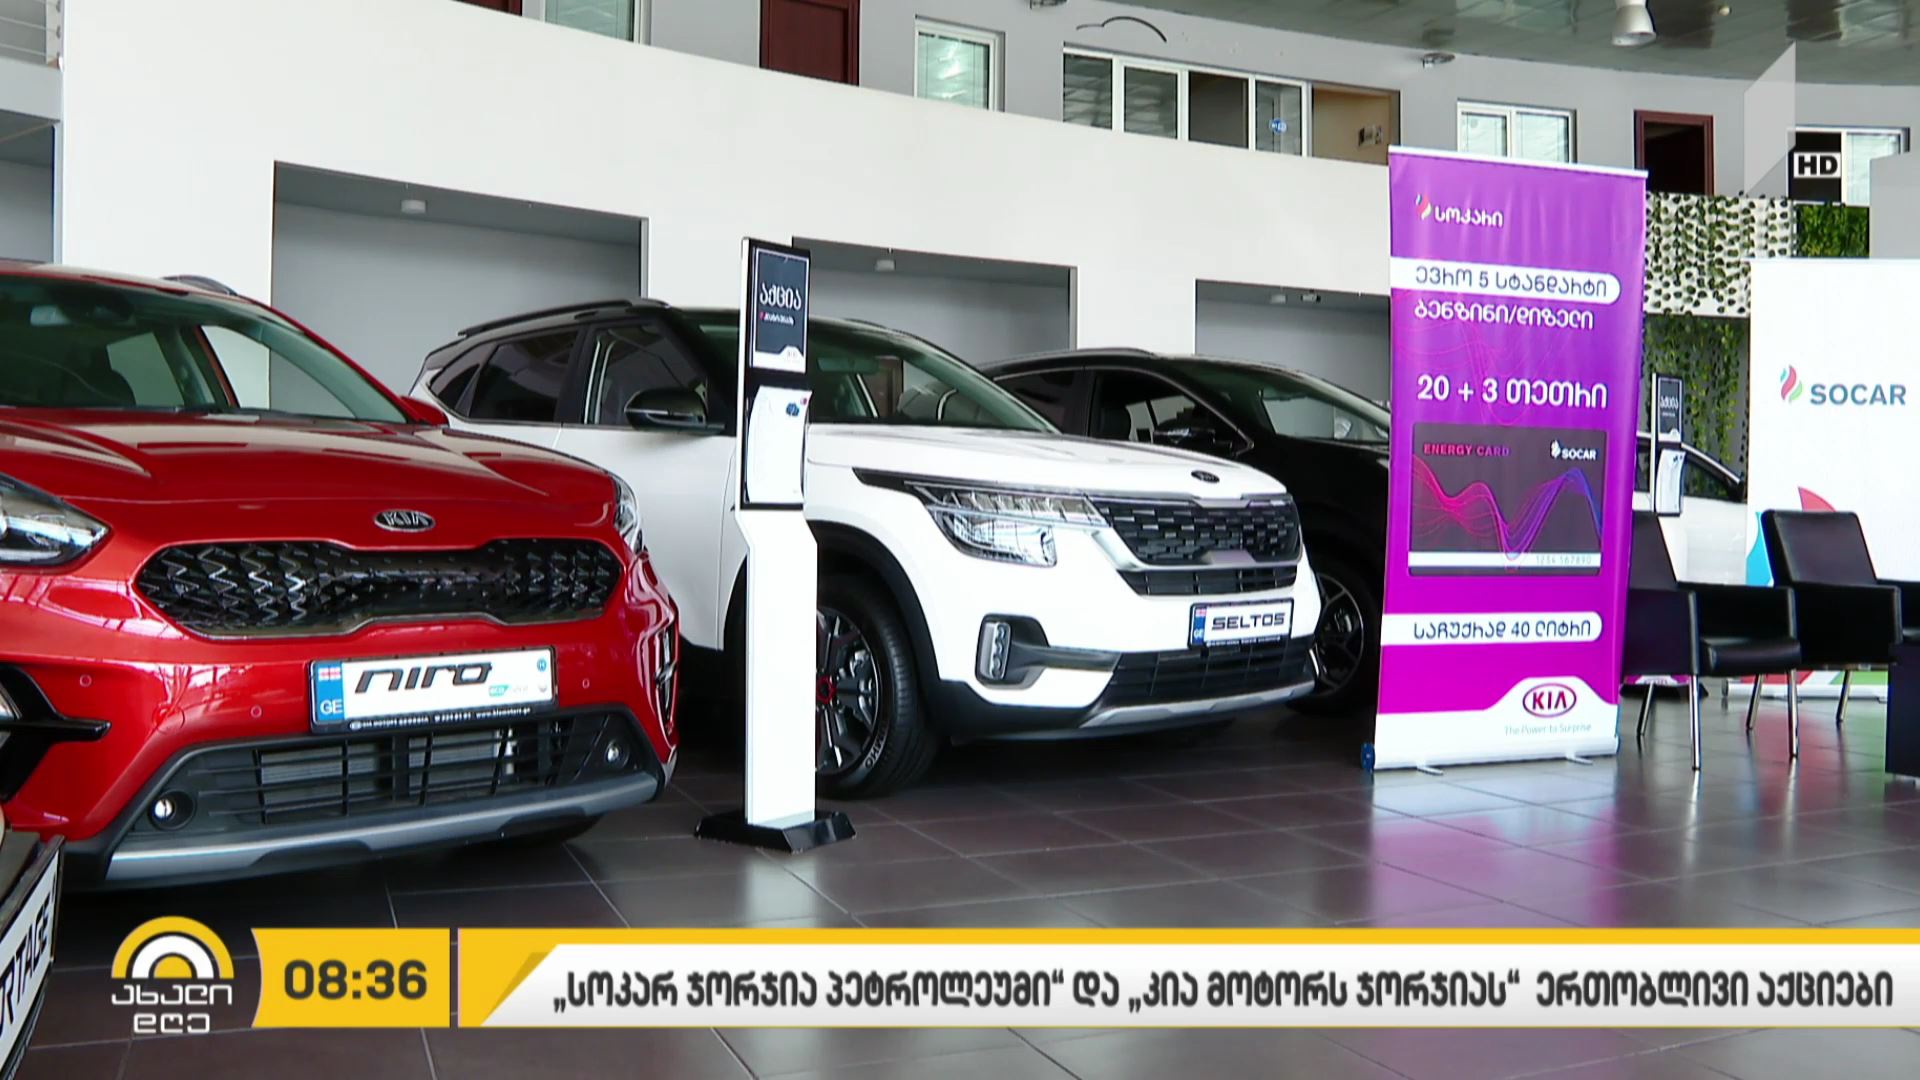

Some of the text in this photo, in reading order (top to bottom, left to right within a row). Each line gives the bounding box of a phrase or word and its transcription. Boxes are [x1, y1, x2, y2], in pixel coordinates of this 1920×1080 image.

[1434, 204, 1503, 229] სოკარი
[1415, 266, 1607, 298] ევრო 5 სტანდარტი
[1414, 300, 1594, 330] ბენზინი/დიზელი
[1417, 374, 1449, 401] 20
[1482, 377, 1498, 403] 3
[1506, 378, 1608, 408] თეთრი
[1811, 384, 1907, 406] SOCAR
[1423, 444, 1510, 457] ENERGY CARD
[1561, 449, 1597, 460] SOCAR
[1212, 612, 1285, 631] SELTOS
[1413, 619, 1591, 640] საჩუქრად 40 ლიტრი
[320, 699, 344, 715] GE
[1532, 691, 1567, 710] KIA
